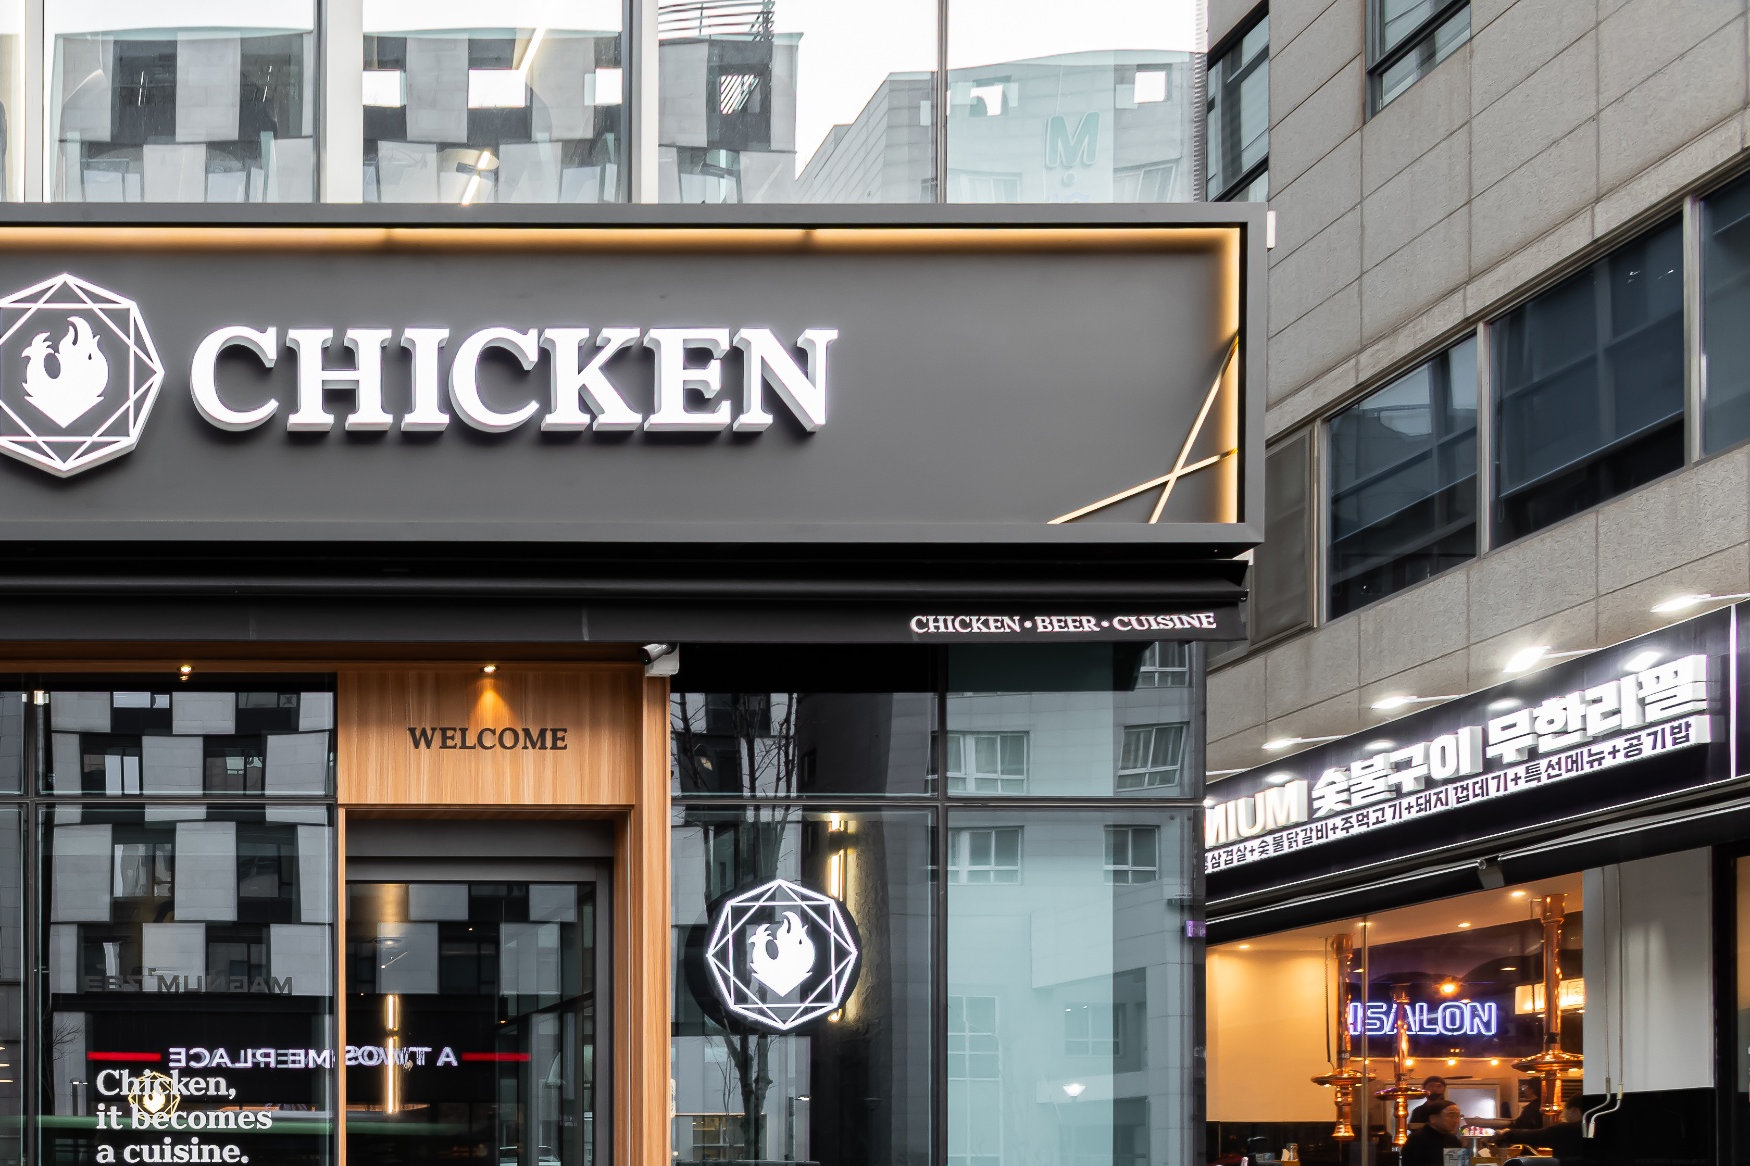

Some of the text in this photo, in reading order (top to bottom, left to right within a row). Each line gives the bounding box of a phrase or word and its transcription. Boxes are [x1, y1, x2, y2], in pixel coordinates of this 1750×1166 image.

[189, 326, 839, 433] CHICKEN
[407, 727, 568, 751] WELCOME
[1311, 725, 1484, 819] 숯불구이
[1485, 654, 1708, 765] 무한리필
[96, 1068, 237, 1100] Chicken,
[96, 1103, 273, 1130] it becomes
[96, 1136, 250, 1164] a cuisine.
